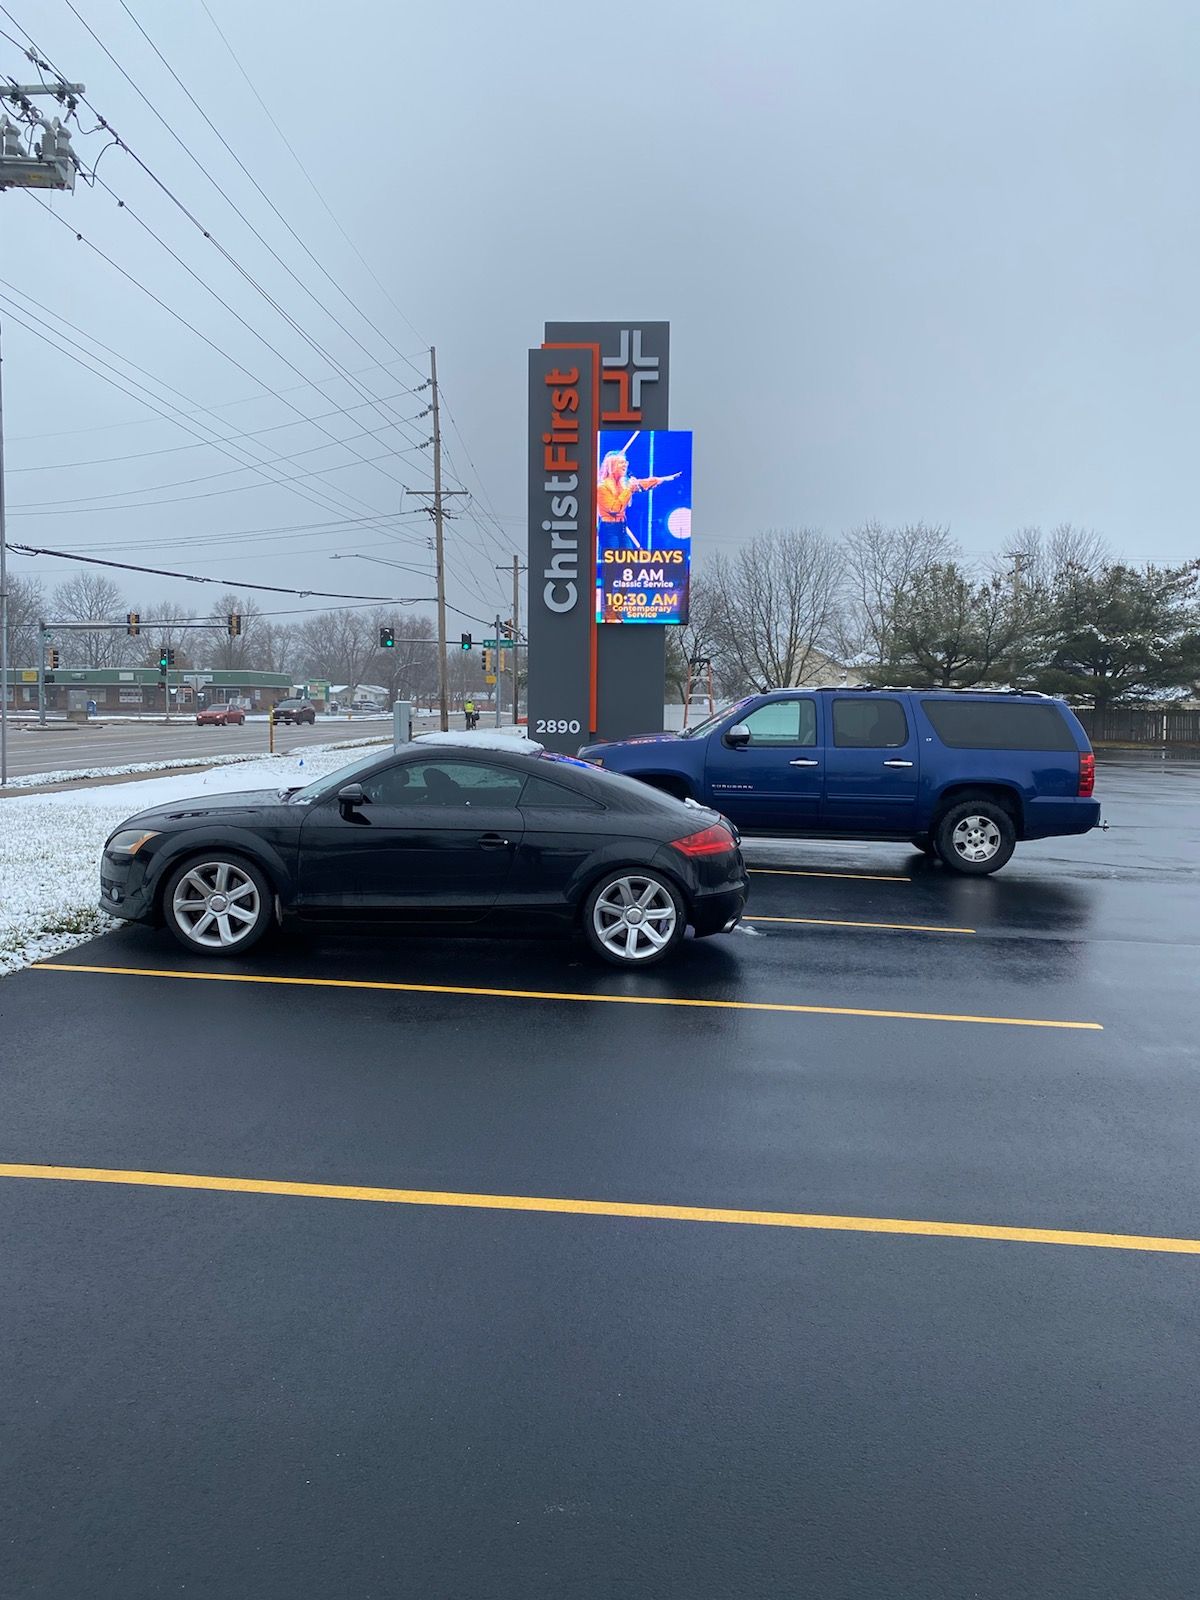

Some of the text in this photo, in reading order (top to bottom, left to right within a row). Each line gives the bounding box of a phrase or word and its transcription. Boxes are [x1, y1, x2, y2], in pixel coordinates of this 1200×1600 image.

[542, 367, 579, 613] ChristFirst
[604, 550, 683, 564] SUNDAYS
[622, 568, 664, 581] 8 AM
[612, 580, 674, 588] Classic Service
[606, 593, 678, 606] 10:30 AM
[612, 606, 672, 614] Contemporary
[536, 719, 580, 733] 2890
